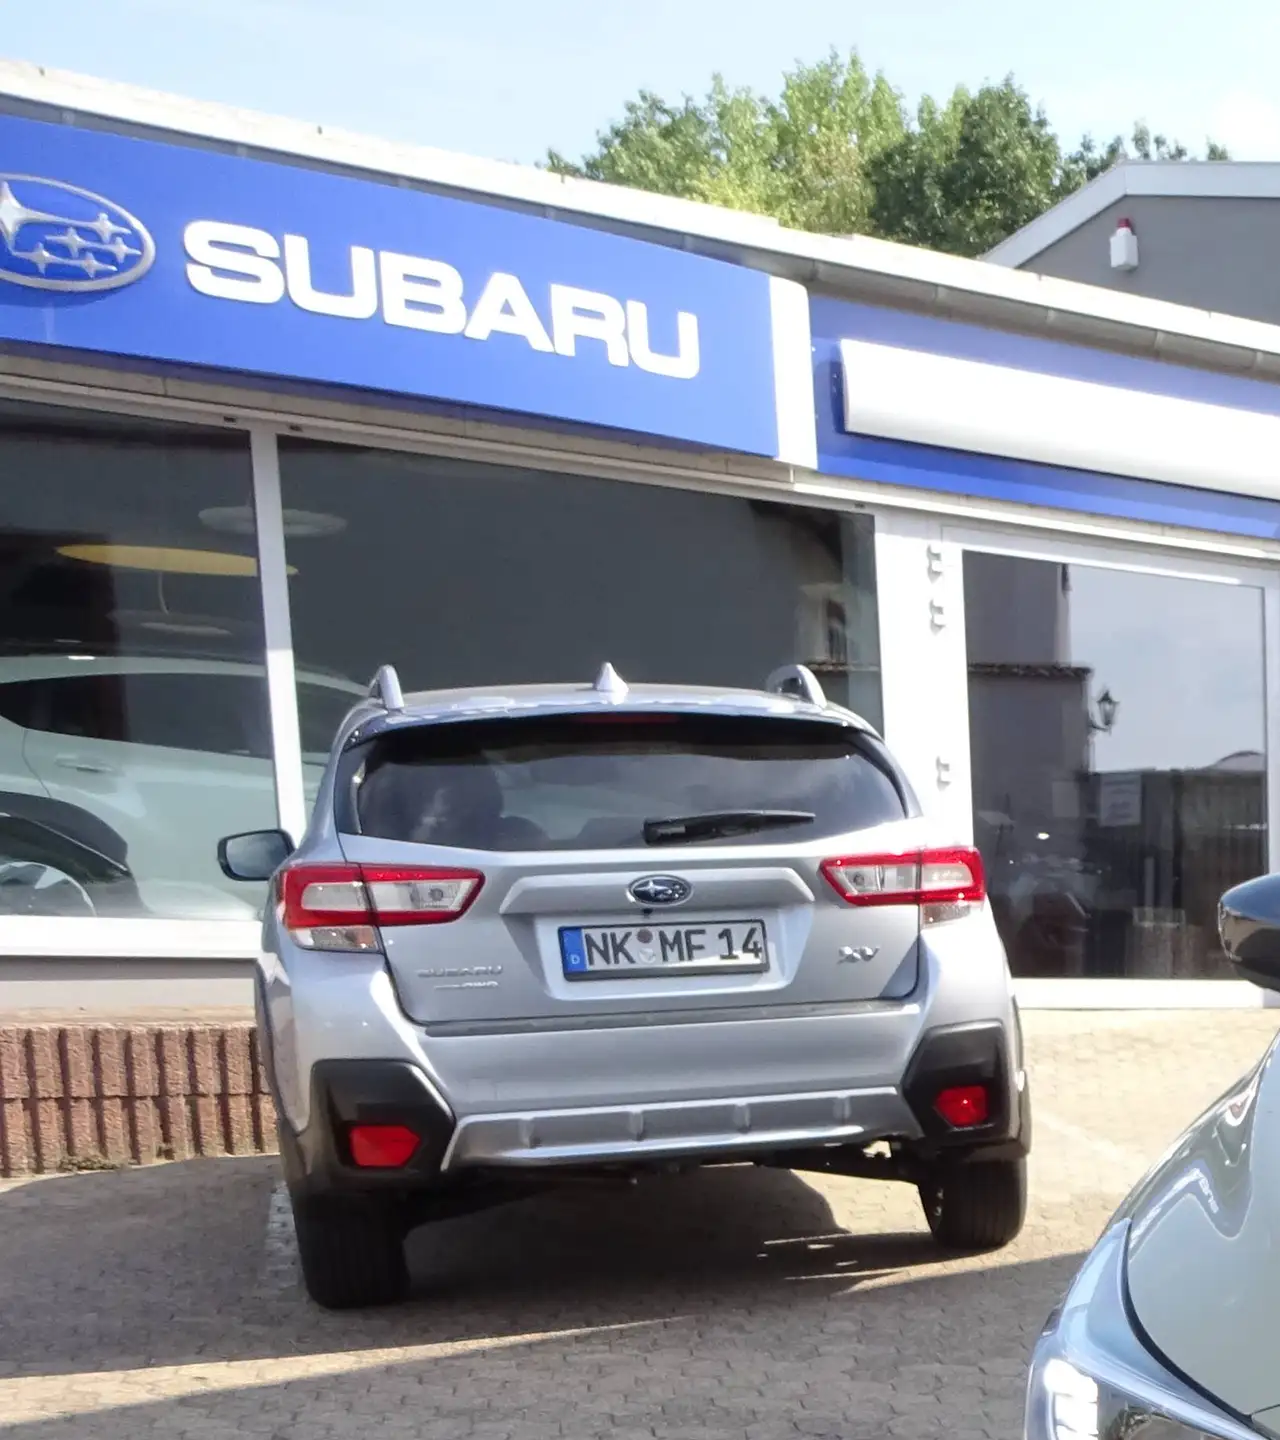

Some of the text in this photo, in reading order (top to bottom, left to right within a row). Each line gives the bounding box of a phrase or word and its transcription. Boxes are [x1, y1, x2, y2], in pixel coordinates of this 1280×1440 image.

[183, 220, 700, 379] SUBARU
[585, 927, 763, 966] NK MF 14
